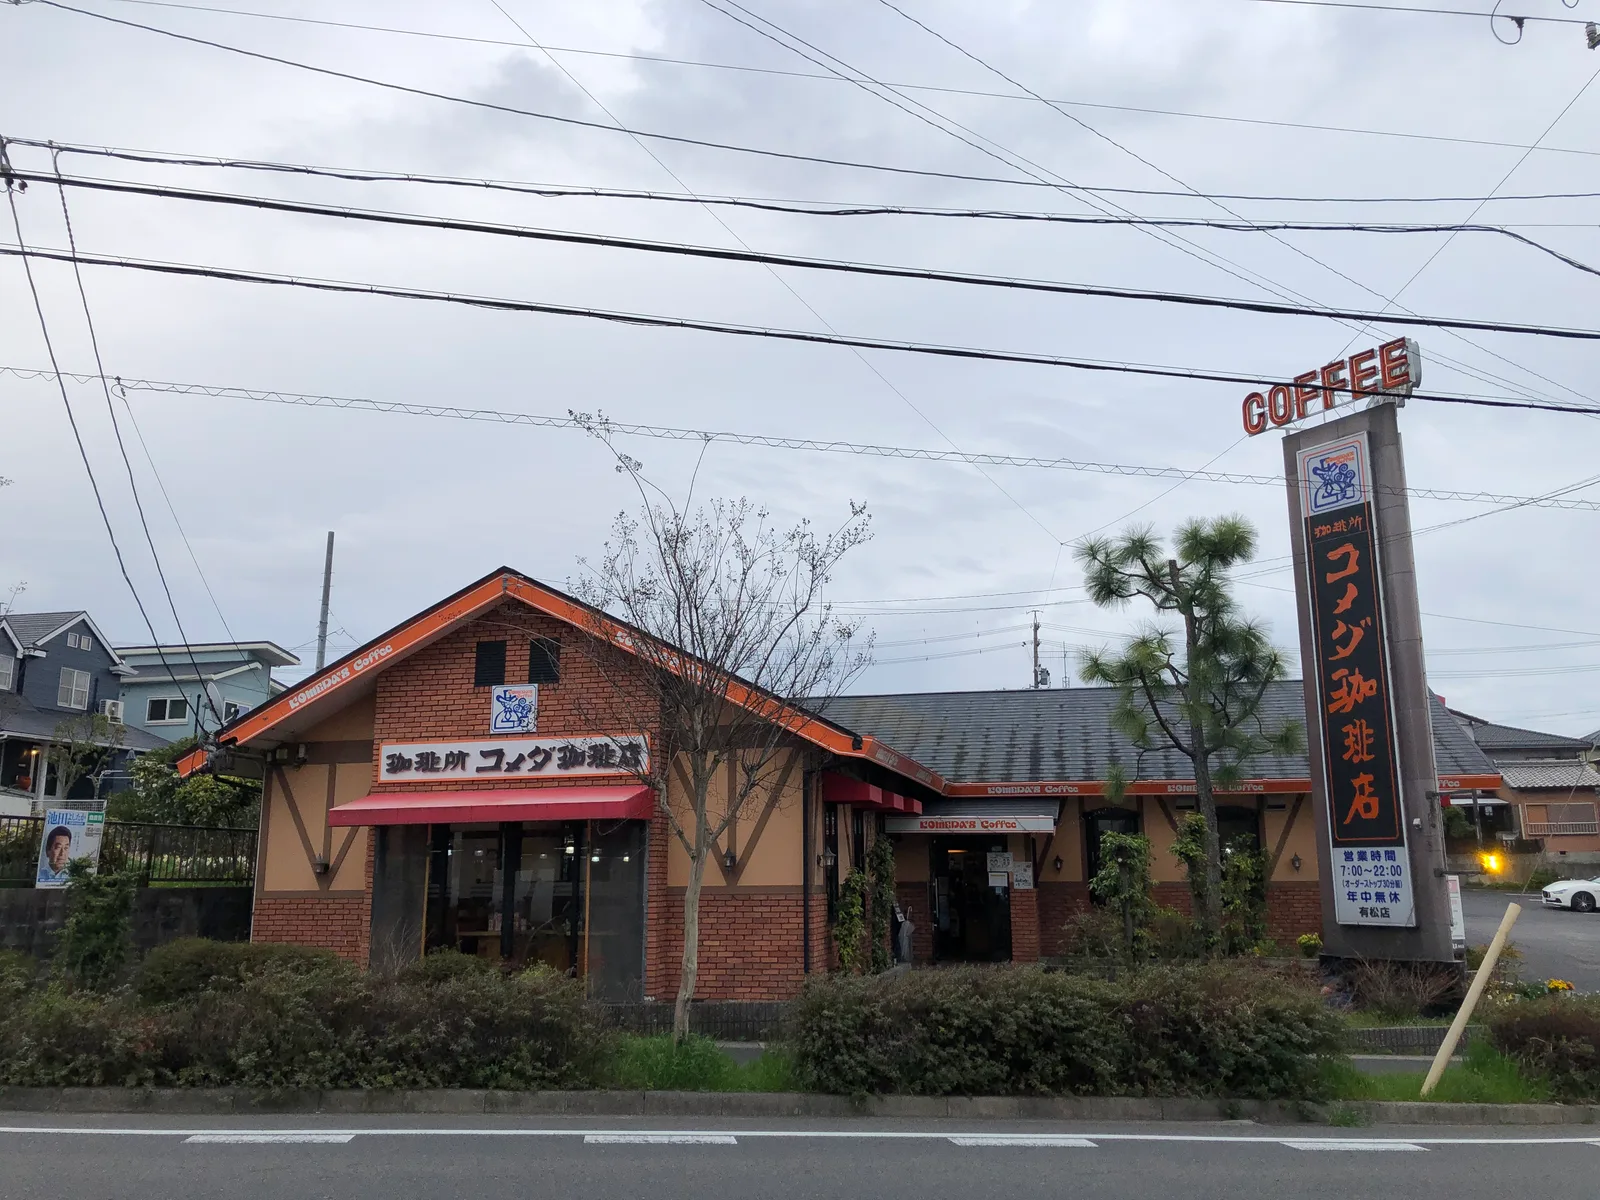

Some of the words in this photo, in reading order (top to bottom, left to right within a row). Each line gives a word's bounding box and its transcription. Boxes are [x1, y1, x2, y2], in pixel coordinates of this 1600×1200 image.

[1242, 336, 1411, 436] COFFEE
[1314, 515, 1363, 538] 珈琲所
[289, 669, 351, 710] KOMEDA'S
[353, 644, 393, 671] Coffee
[1326, 542, 1379, 825] コメダ珈琲店
[385, 751, 470, 774] 珈琲所
[987, 785, 1041, 795] KOMEDA'S
[1045, 784, 1079, 794] Coffee
[919, 820, 976, 830] KOMEDA'S
[980, 820, 1017, 830] Coffee
[1343, 850, 1396, 862] 営業時間
[1346, 891, 1401, 903] 年中無休
[1358, 906, 1391, 919] 有松店
